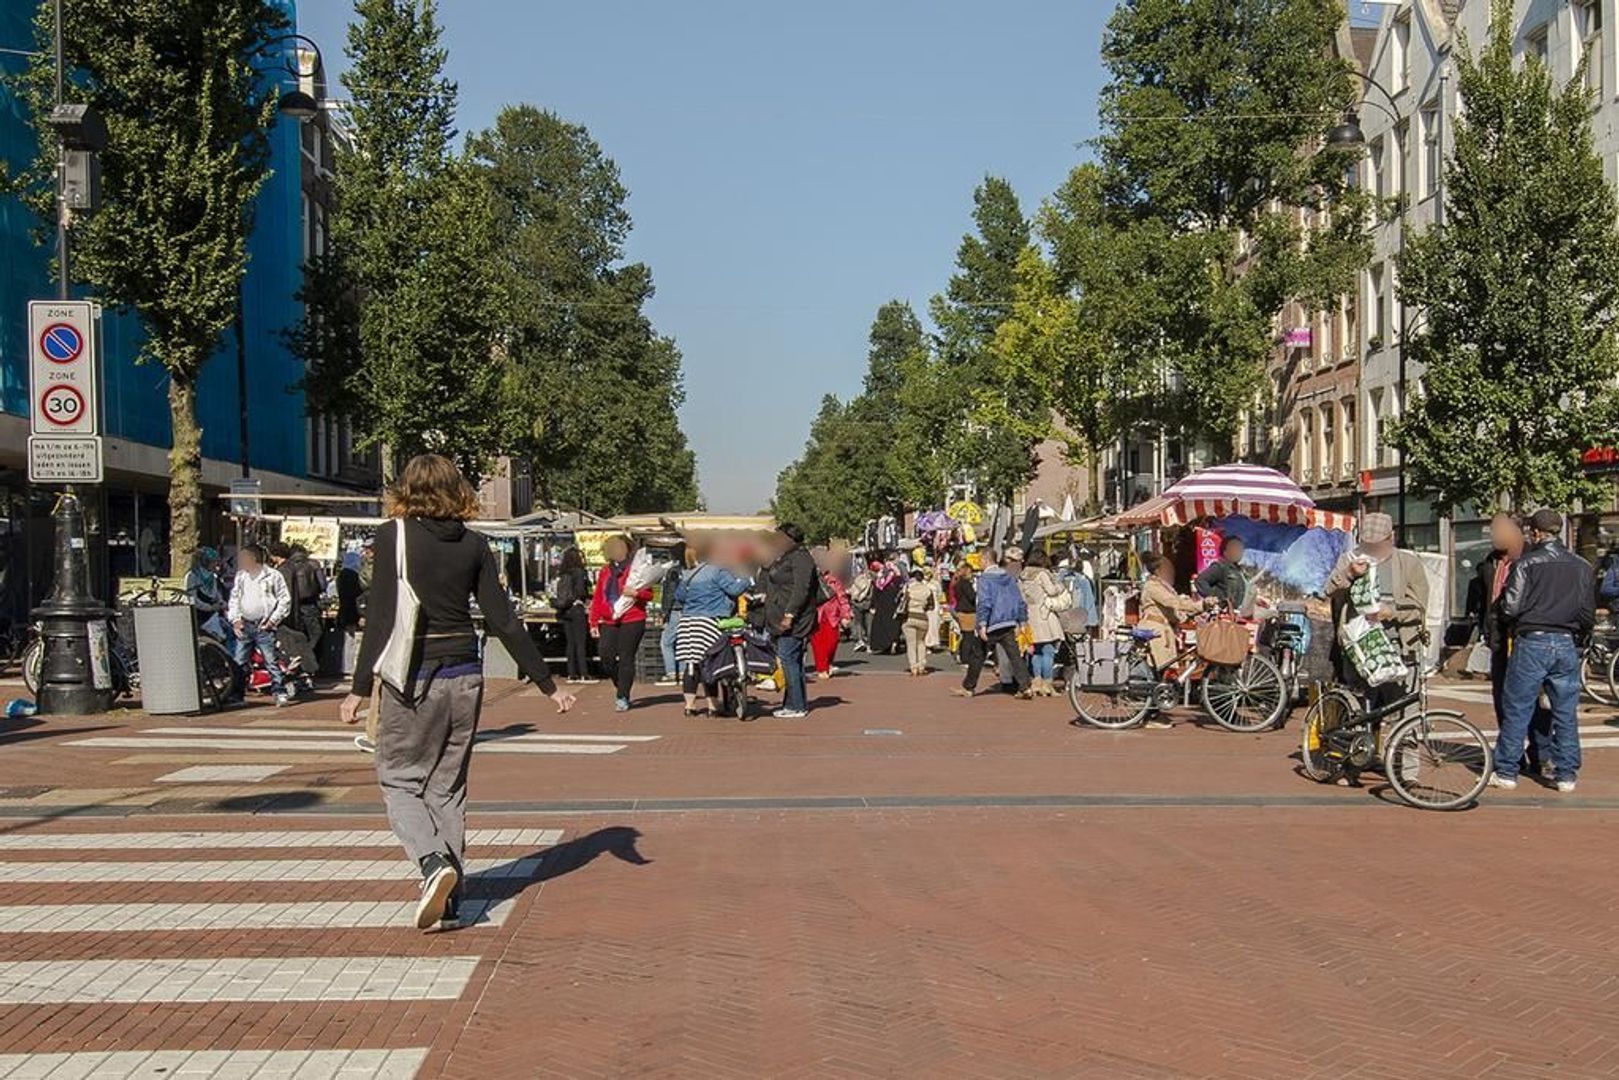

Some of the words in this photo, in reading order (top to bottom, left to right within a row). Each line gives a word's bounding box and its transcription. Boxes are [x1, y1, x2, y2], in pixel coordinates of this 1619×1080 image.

[47, 310, 74, 318] ZONE
[49, 372, 76, 380] ZONE
[49, 397, 77, 414] 30
